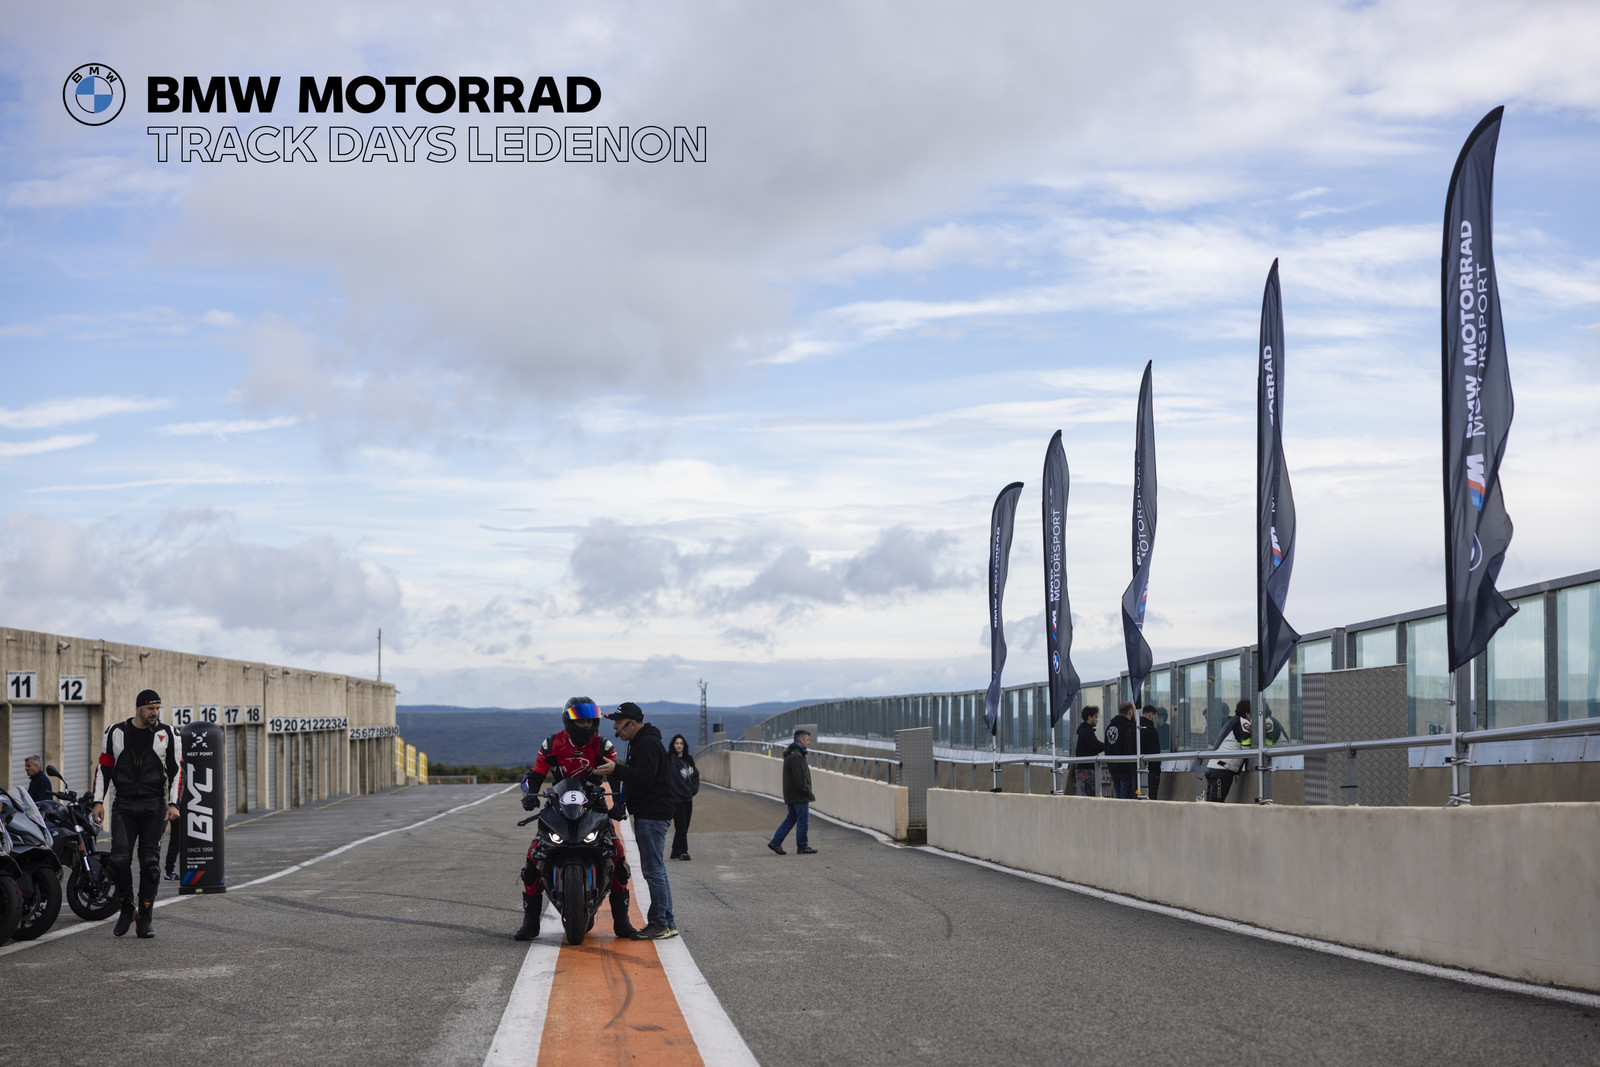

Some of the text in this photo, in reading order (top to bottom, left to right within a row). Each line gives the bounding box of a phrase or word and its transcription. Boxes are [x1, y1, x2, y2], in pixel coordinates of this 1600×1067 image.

[1460, 220, 1477, 366] MOTORRAD
[1053, 508, 1061, 601] MOTORSPORT
[11, 675, 31, 698] 11
[61, 680, 84, 701] 12
[174, 708, 191, 725] 15
[201, 708, 217, 724] 16
[225, 708, 239, 723] 17
[247, 708, 260, 722] 18
[269, 718, 282, 732] 19
[284, 719, 298, 731] 20
[300, 719, 312, 730] 21
[313, 718, 325, 730] 22
[326, 718, 337, 729] 23
[337, 718, 348, 729] 24
[350, 728, 361, 738] 25
[187, 763, 214, 842] BMC
[571, 794, 577, 802] 5
